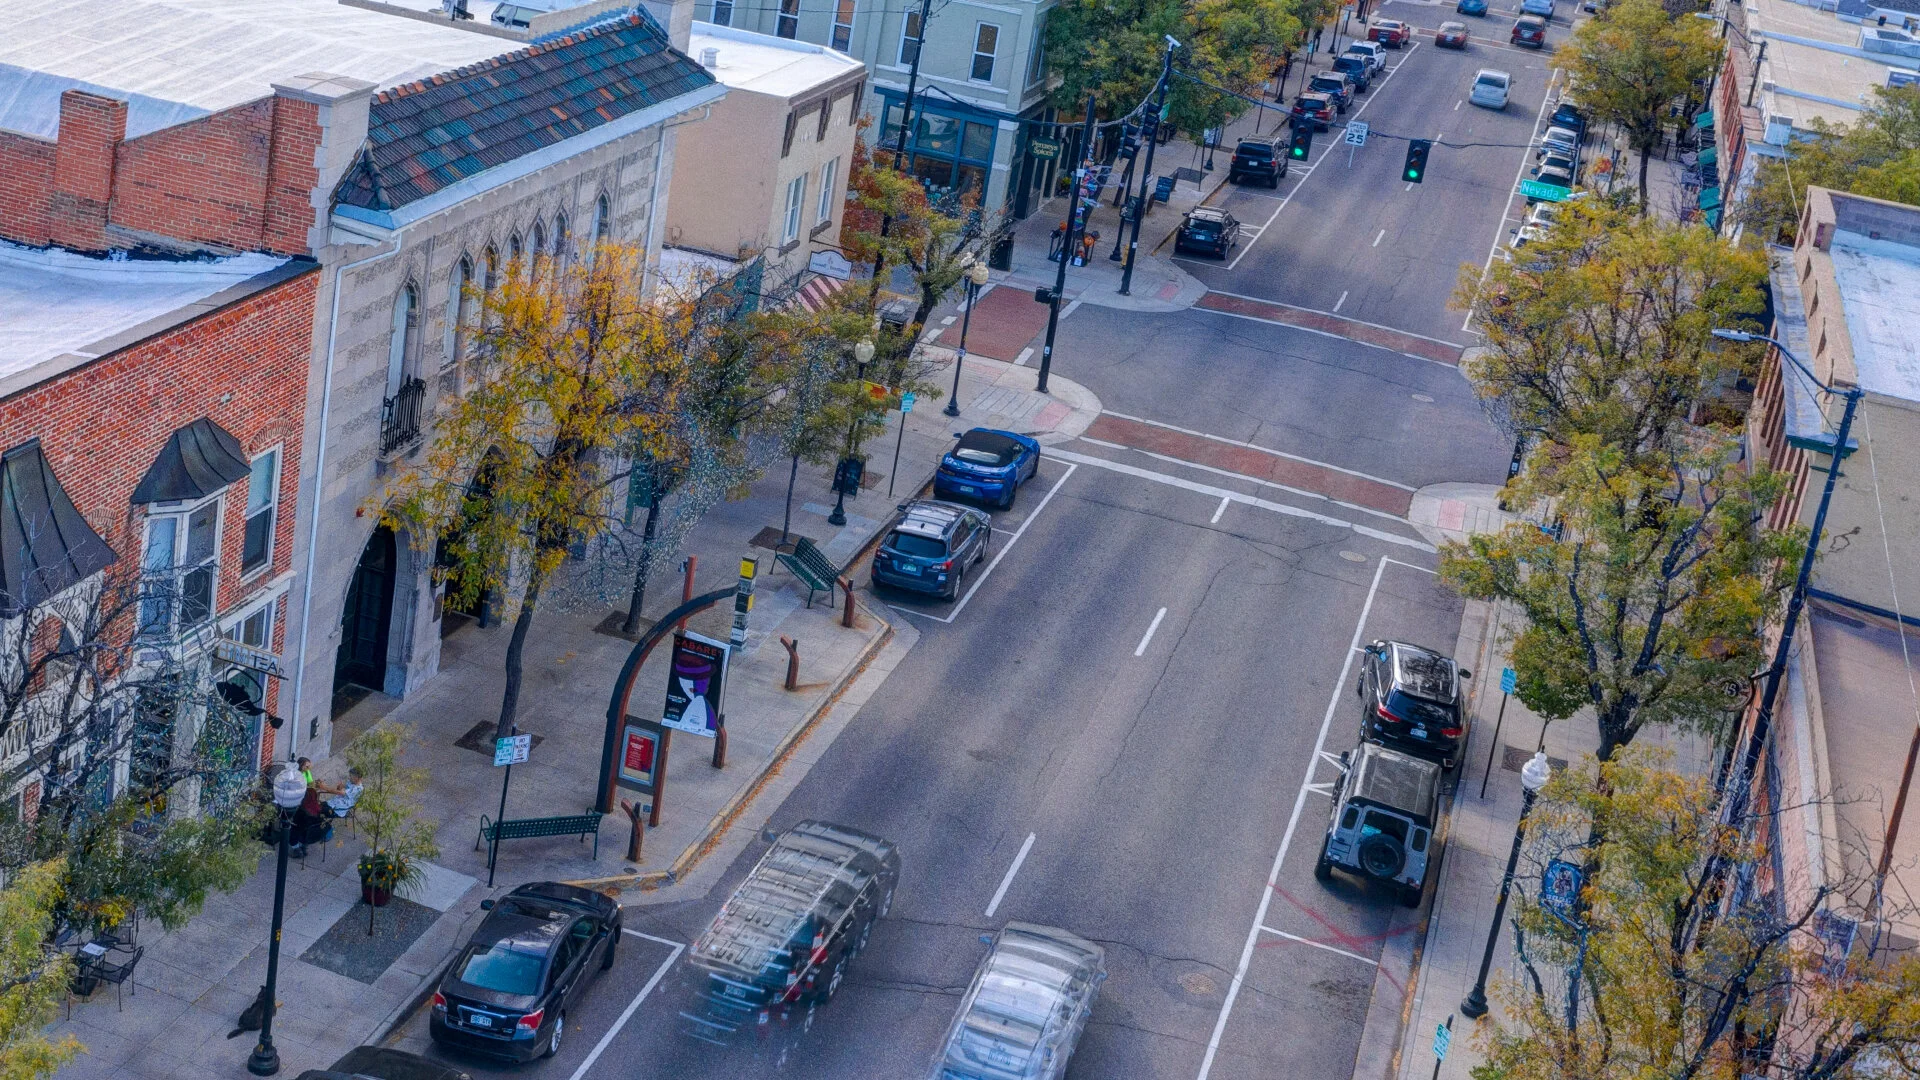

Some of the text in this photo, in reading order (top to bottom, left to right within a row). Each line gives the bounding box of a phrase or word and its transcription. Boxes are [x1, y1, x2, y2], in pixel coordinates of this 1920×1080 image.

[1349, 122, 1366, 130] SPEED
[1347, 133, 1363, 144] 25
[1521, 181, 1559, 200] Nevada
[675, 637, 723, 657] CABARET
[251, 653, 278, 675] TEA
